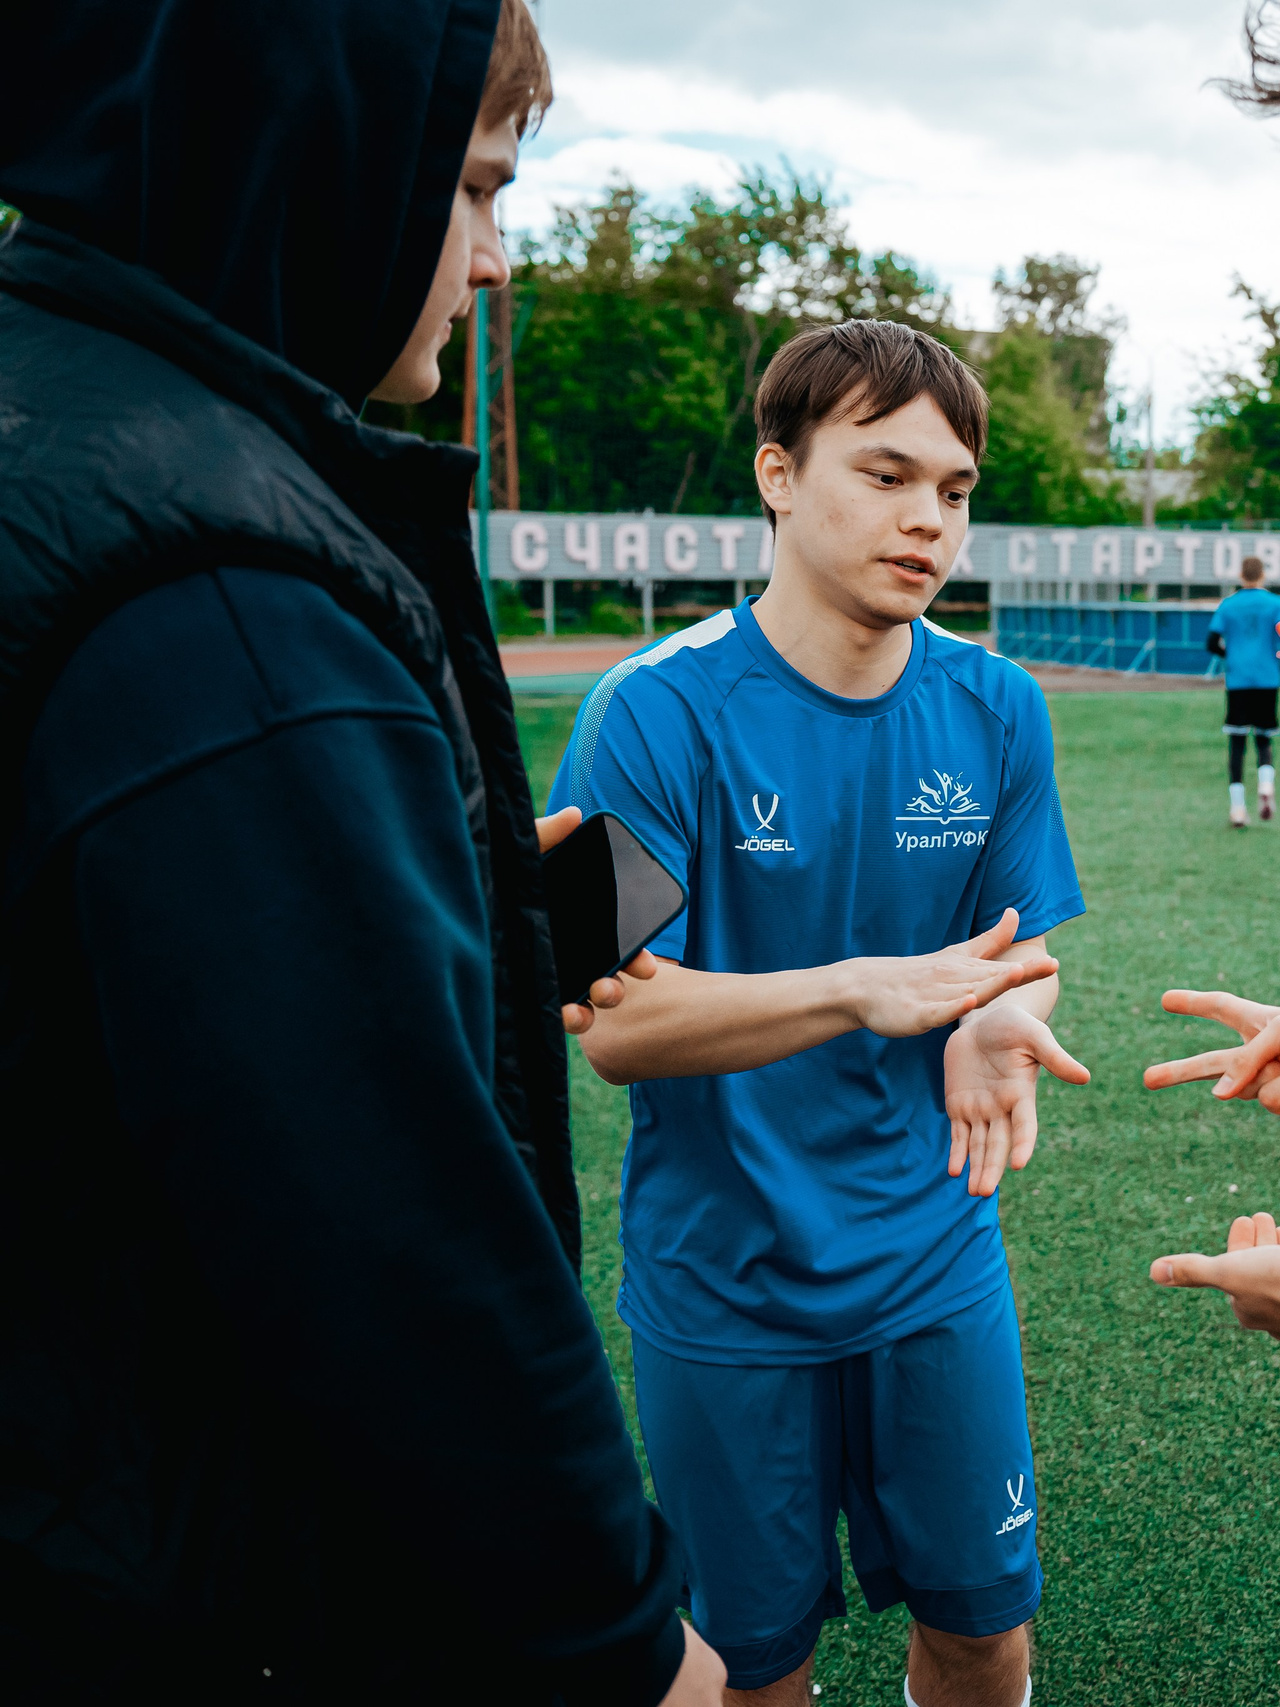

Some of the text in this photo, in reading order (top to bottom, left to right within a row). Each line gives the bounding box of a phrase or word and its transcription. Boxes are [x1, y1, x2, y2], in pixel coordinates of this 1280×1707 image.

[735, 835, 796, 852] JÖGEL
[895, 830, 989, 852] УралГУФК
[995, 1508, 1035, 1536] JÖGEL
